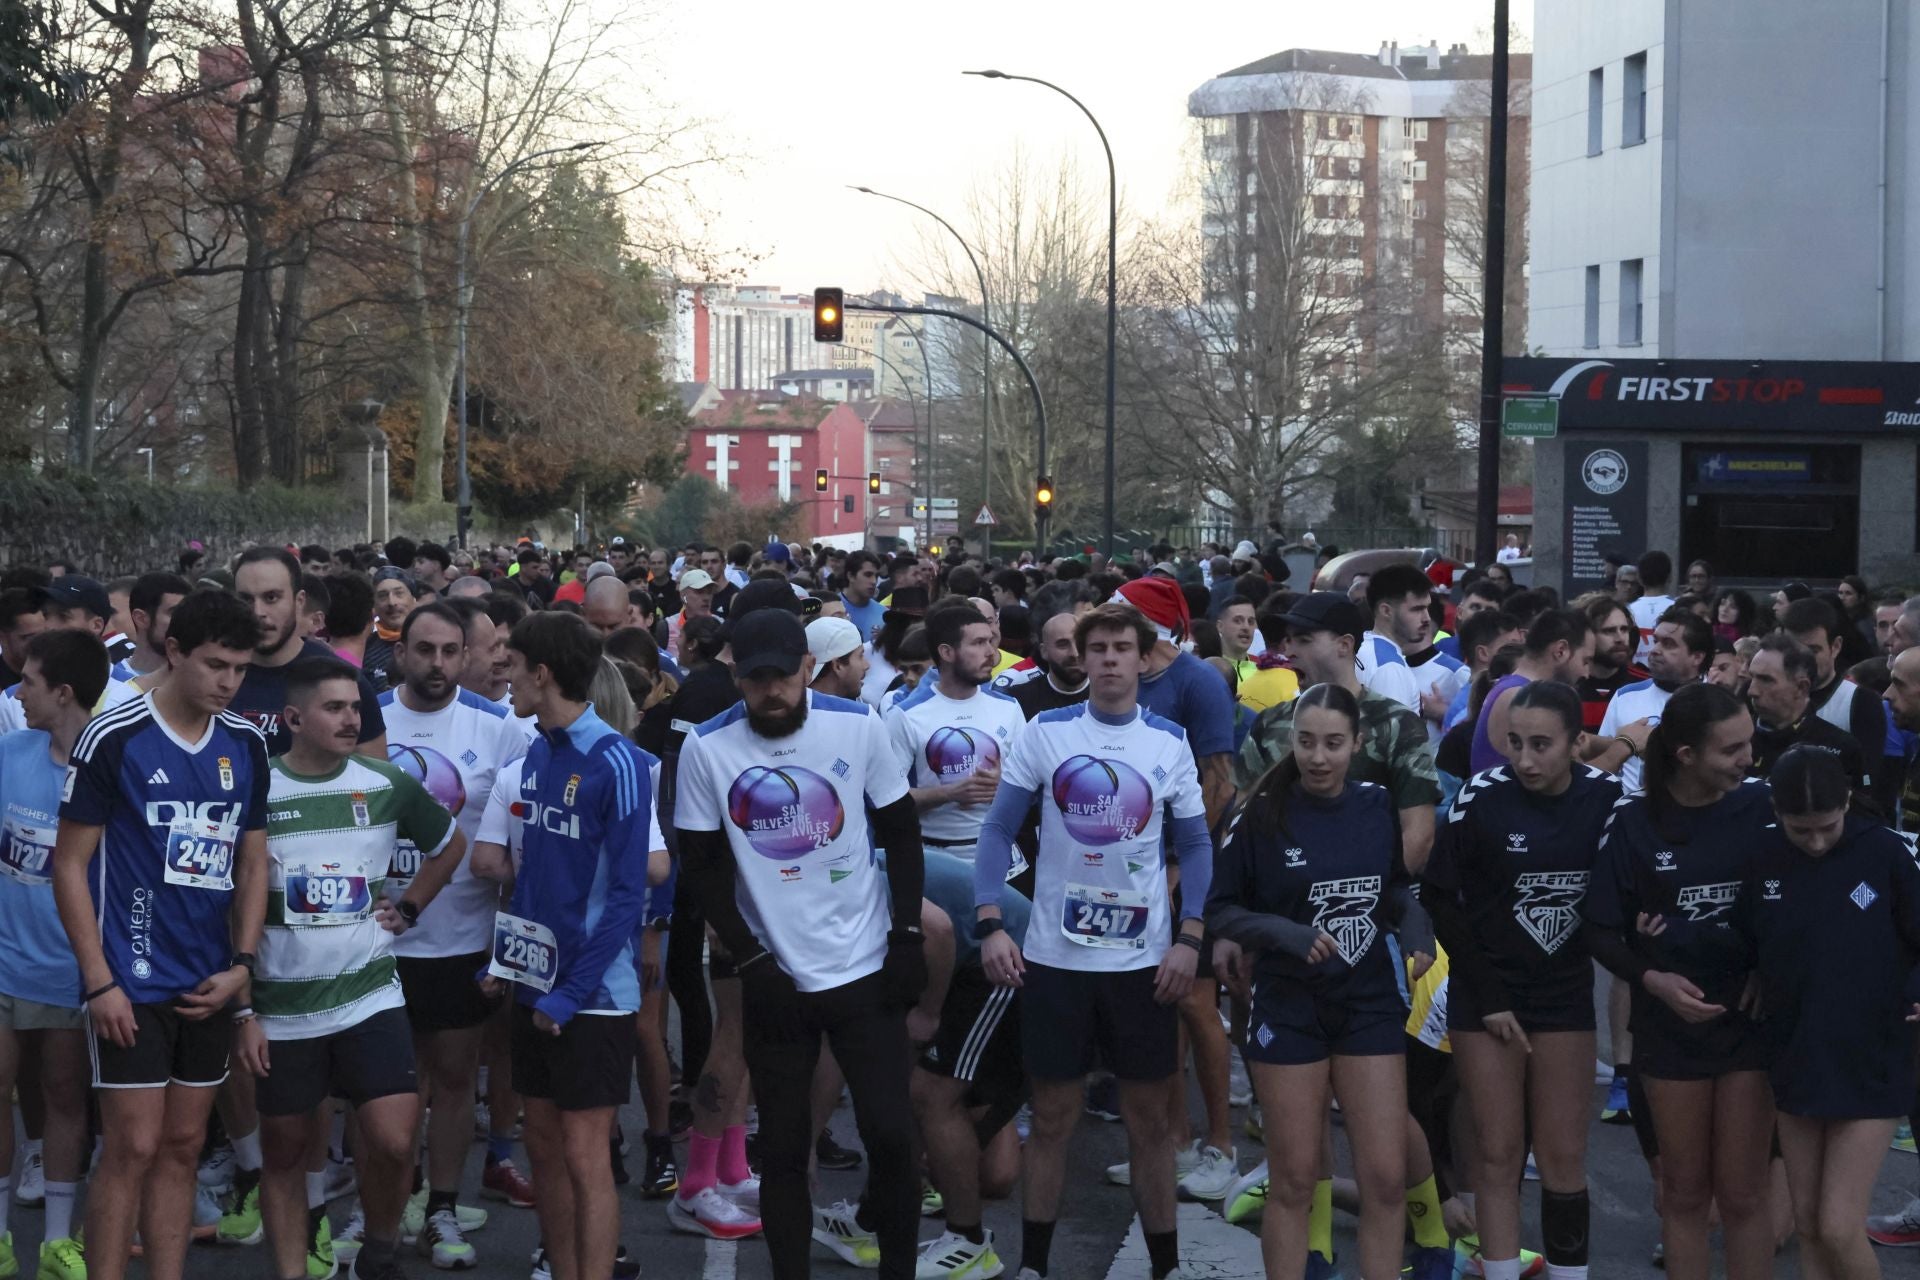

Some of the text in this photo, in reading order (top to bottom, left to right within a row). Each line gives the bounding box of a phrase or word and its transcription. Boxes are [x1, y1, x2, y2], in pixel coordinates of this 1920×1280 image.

[1506, 423, 1554, 431] CERVANTES
[7, 802, 49, 821] FINISHER
[9, 836, 50, 871] 1727
[177, 840, 229, 873] 2449
[306, 878, 353, 905] 892
[130, 887, 146, 955] OVIEDO
[1077, 904, 1134, 934] 2417
[503, 936, 550, 974] 2266
